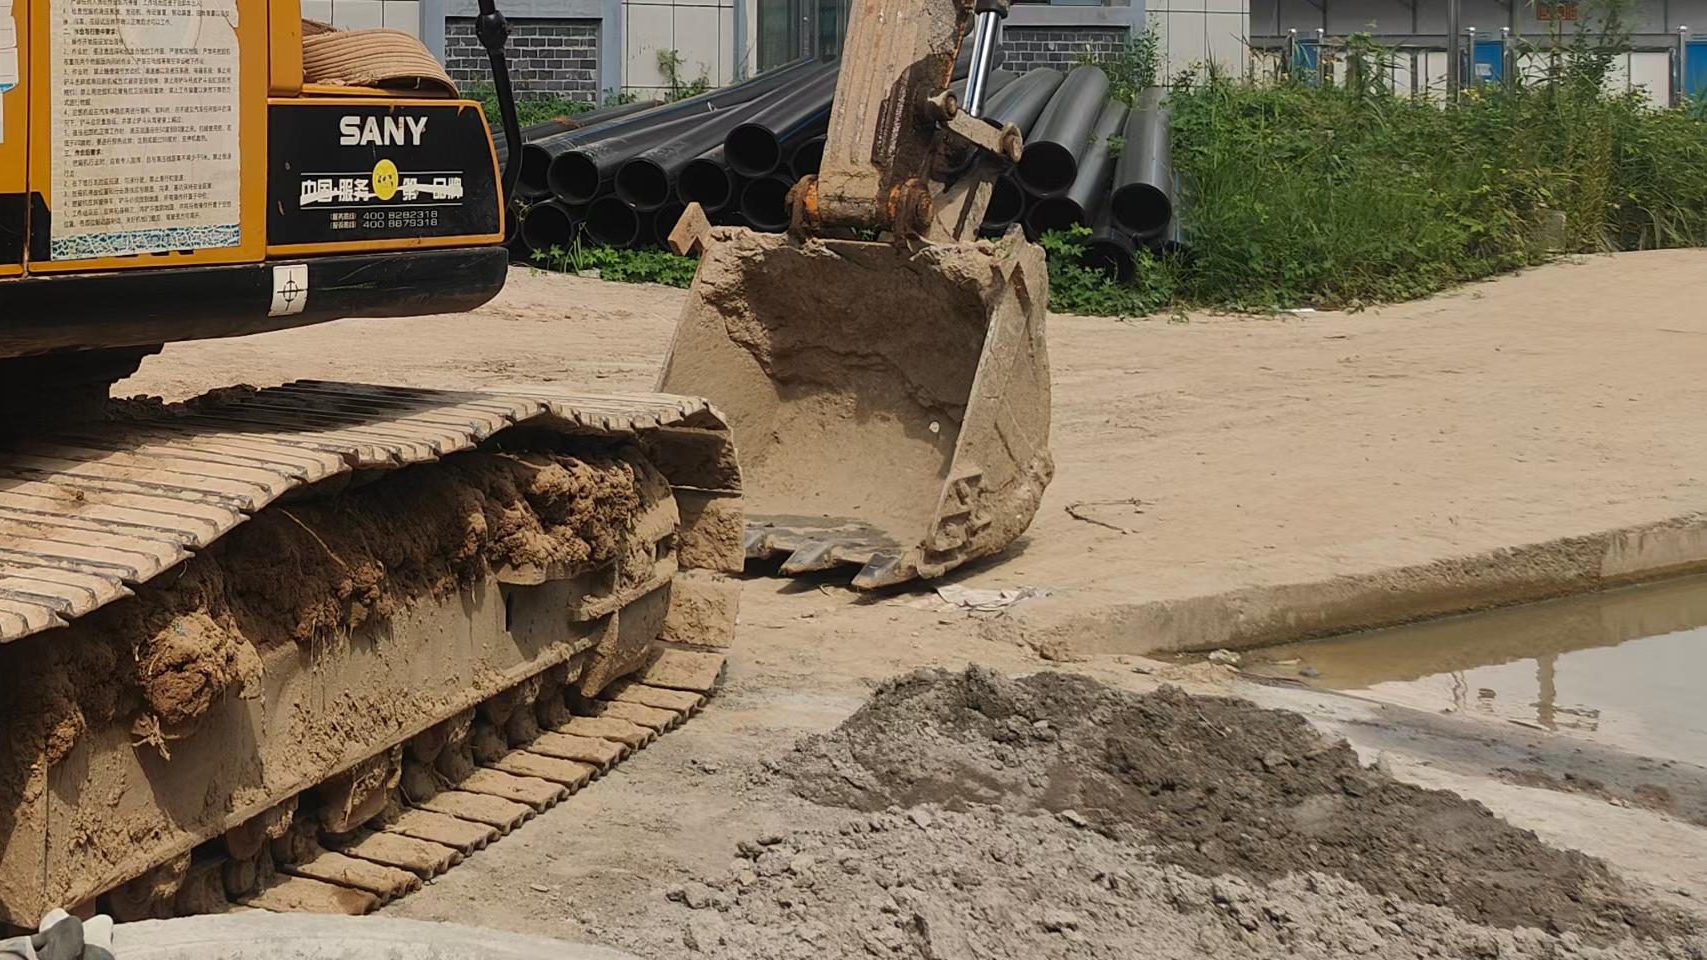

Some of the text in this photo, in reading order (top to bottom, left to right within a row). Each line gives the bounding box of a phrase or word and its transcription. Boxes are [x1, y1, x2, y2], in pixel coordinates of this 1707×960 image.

[339, 116, 428, 146] SANY
[363, 211, 385, 220] 400
[388, 210, 438, 219] 8282318
[363, 220, 385, 228] 400
[388, 219, 438, 228] 8879318
